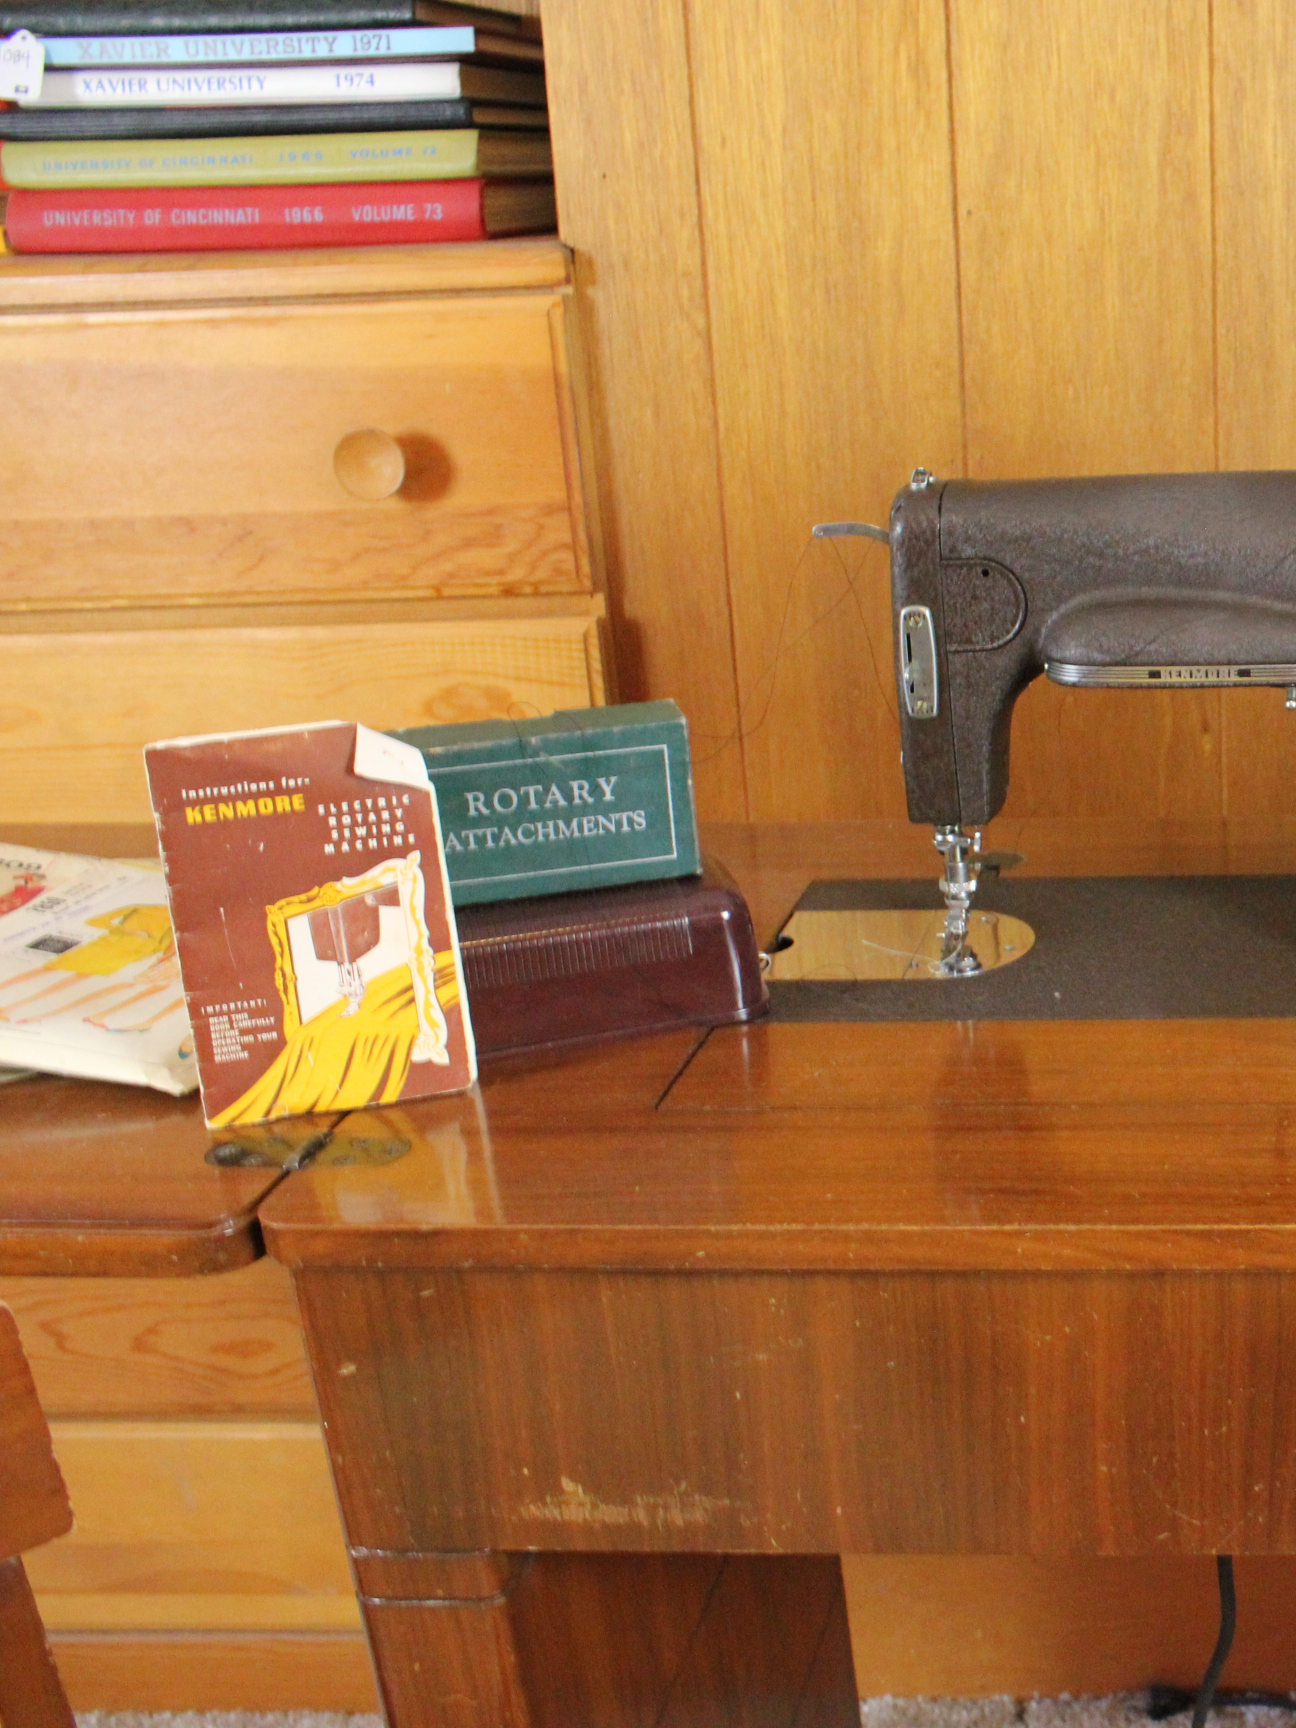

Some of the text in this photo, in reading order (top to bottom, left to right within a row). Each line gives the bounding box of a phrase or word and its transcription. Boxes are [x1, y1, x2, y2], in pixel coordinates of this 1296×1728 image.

[76, 34, 392, 61] XAVIER UNIVERSITY 1971
[82, 72, 376, 94] XAVIER UNIVERSITY 1974
[42, 158, 132, 171] UNIVERSITY
[138, 157, 155, 168] OF
[161, 154, 254, 168] CINCINNATI
[350, 147, 413, 160] VOLUME
[42, 202, 443, 226] UNIVERSITY OF CINCINNATI 1966 VOLUME 73
[1161, 667, 1239, 681] KENMORE
[181, 780, 275, 800] Instructions
[463, 775, 618, 818] ROTARY
[185, 793, 306, 826] KENMORE
[318, 793, 410, 816] ELECTRIC
[328, 807, 403, 828] ROTARY
[331, 821, 405, 841] SEWING
[443, 809, 647, 853] ATTACHMENTS
[324, 832, 416, 855] MACHINE
[257, 1031, 278, 1043] YOUR
